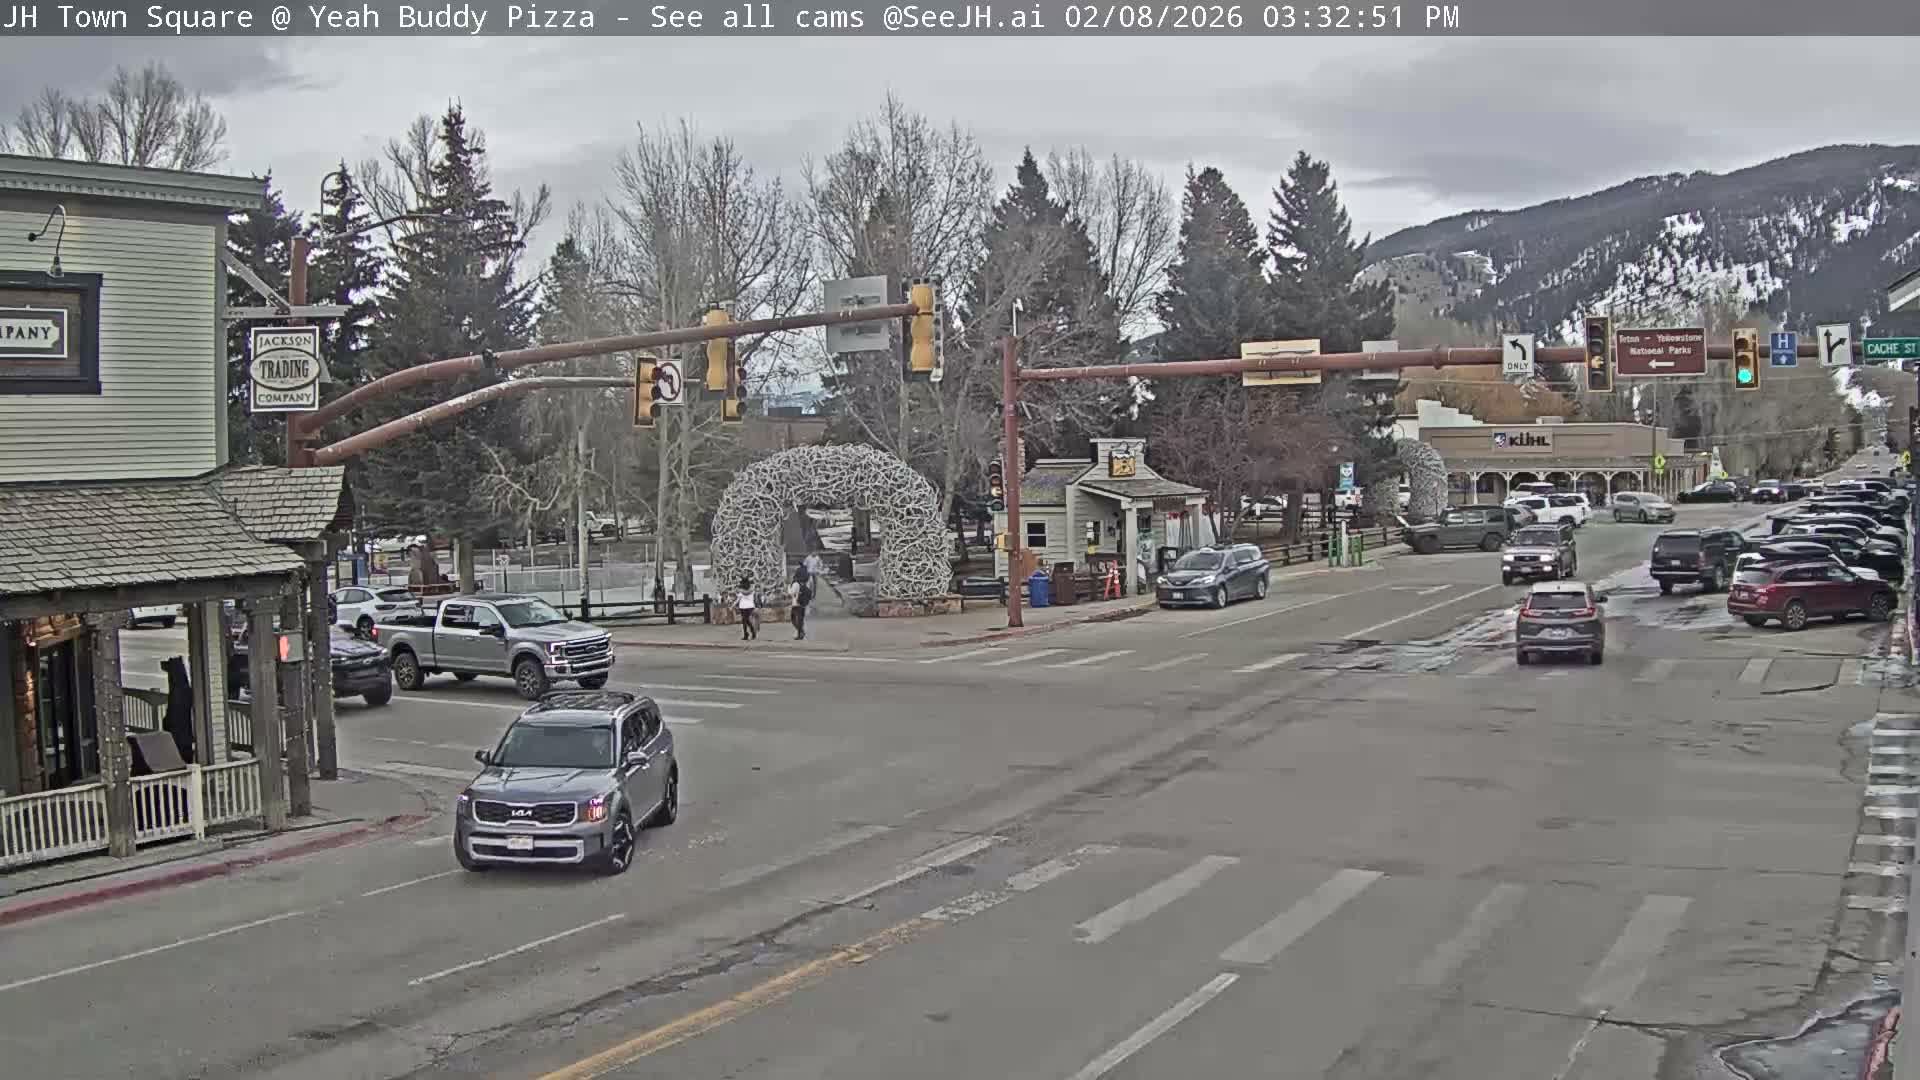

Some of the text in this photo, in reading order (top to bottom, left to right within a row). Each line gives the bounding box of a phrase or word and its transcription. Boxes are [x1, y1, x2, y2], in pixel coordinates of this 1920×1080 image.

[0, 325, 51, 340] PANY
[259, 335, 312, 348] JACKSON
[1619, 334, 1640, 343] Teton
[1629, 345, 1692, 355] National Parks
[1867, 343, 1917, 354] CACHE ST
[259, 359, 309, 379] TRADING
[1507, 362, 1529, 370] ONLY
[258, 393, 312, 403] COMPANY
